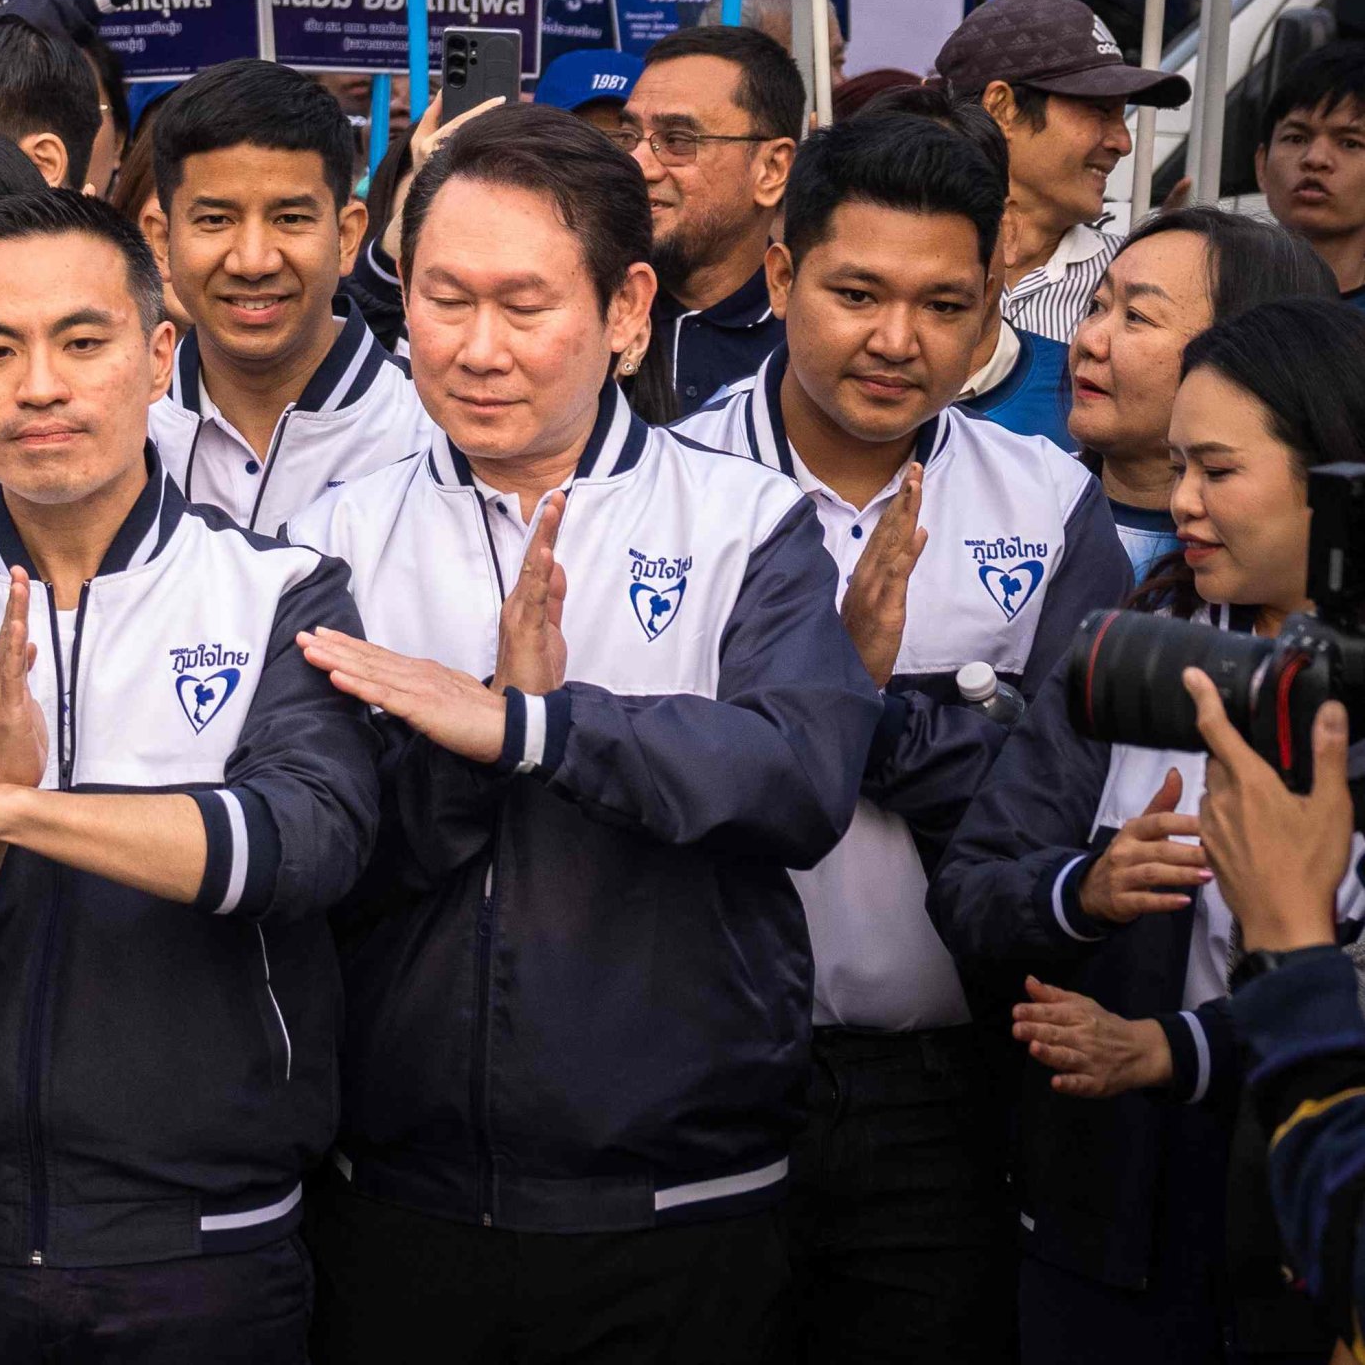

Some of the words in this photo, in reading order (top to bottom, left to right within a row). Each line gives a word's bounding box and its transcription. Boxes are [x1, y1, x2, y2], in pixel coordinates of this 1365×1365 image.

[591, 73, 627, 92] 1987
[972, 536, 1048, 565] ภูมิใจไทย
[172, 643, 249, 674] ภูมิใจไทย
